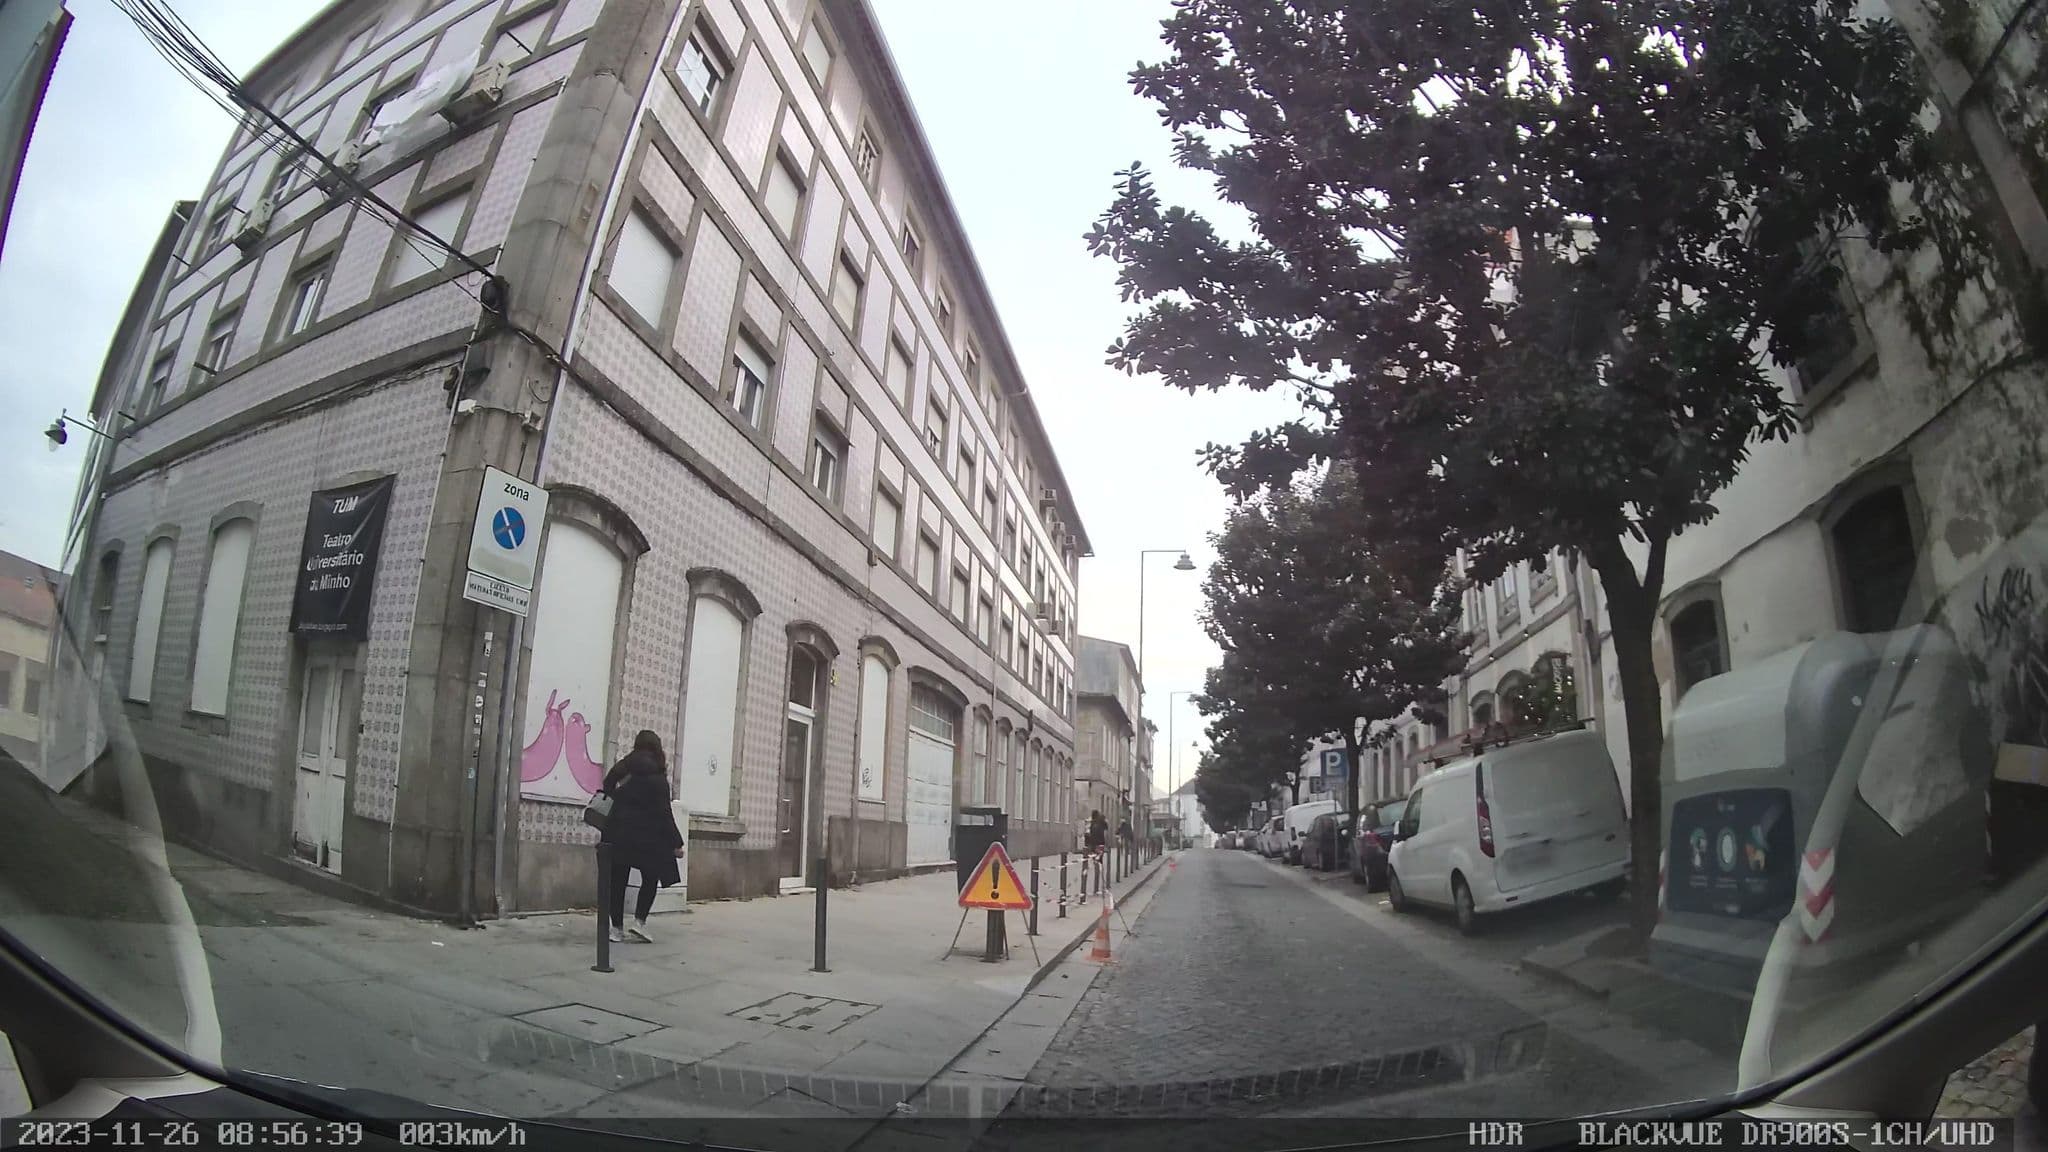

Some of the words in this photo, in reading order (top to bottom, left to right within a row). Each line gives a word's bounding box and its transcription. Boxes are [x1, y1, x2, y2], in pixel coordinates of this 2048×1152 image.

[503, 481, 530, 503] zona
[332, 495, 359, 515] TUM
[321, 532, 353, 549] Teatro
[306, 548, 364, 572] Universitário
[319, 572, 351, 591] Minho
[1325, 751, 1342, 776] P
